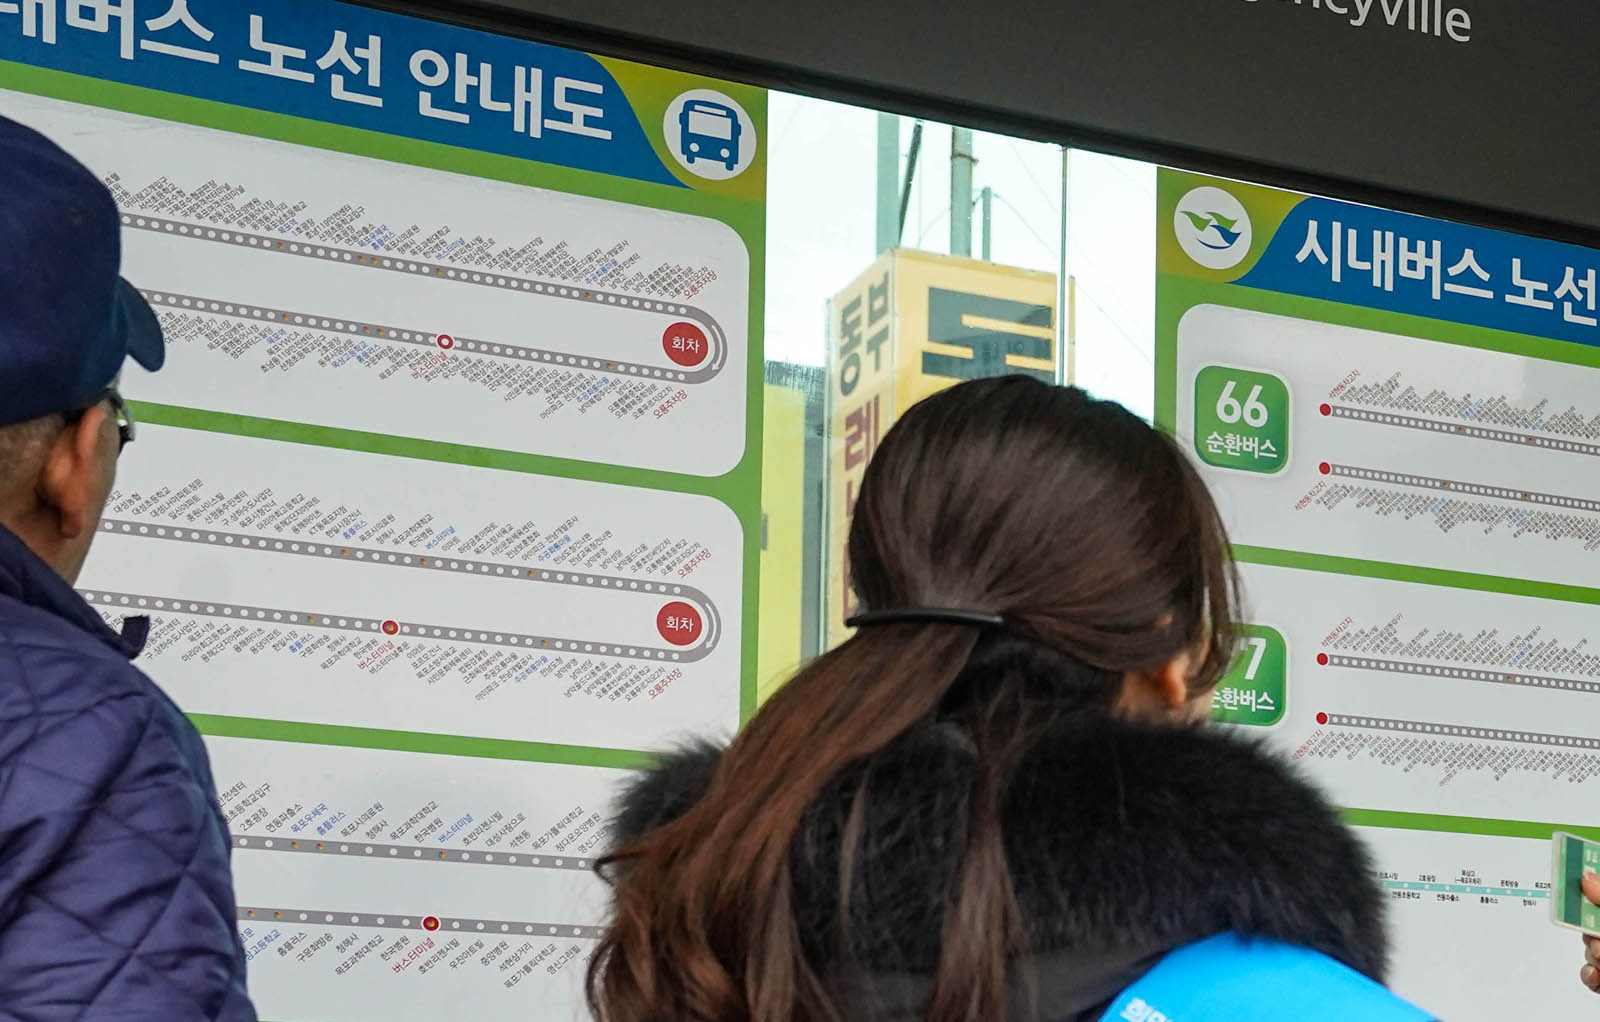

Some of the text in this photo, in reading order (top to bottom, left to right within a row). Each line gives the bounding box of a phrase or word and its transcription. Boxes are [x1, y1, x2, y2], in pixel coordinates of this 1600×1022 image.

[1240, 0, 1472, 42] yville
[238, 14, 384, 108] 노선
[409, 48, 613, 140] 안내도
[1295, 219, 1494, 301] 시내버스
[1504, 257, 1597, 327] 노선
[670, 336, 701, 353] 회차
[1215, 379, 1269, 428] 66
[1205, 430, 1278, 459] 순환버스
[665, 615, 695, 633] 회차
[238, 806, 268, 832] 2호광장
[264, 802, 302, 832] 연동파출소
[290, 802, 328, 834] 목포우체국
[316, 810, 346, 834] 홈플러스
[340, 802, 384, 838] 목포시의료원
[364, 818, 388, 838] 청해사
[388, 800, 438, 840] 목포과학대학교
[414, 816, 442, 842] 한국병원
[436, 812, 474, 844] 버스터미널
[462, 810, 502, 846] 호반리젠시빌
[484, 812, 526, 848] 대성사랑으로
[530, 806, 584, 850] 목포가톨릭대학교
[508, 828, 530, 848] 석현동
[276, 930, 308, 956] 홈플러스
[296, 932, 332, 962] 구문화방송
[334, 934, 384, 976] 목포과학대학교
[336, 932, 360, 954] 청해사
[380, 936, 410, 962] 한국병원
[392, 938, 434, 974] 버스터미널
[418, 938, 460, 974] 호반리젠시빌
[448, 940, 484, 970] 우진아트빌
[480, 940, 510, 966] 중앙병원
[498, 942, 534, 972] 석현삼거리
[502, 944, 558, 988] 목포가톨릭대학교
[546, 944, 582, 974] 영신그린빌
